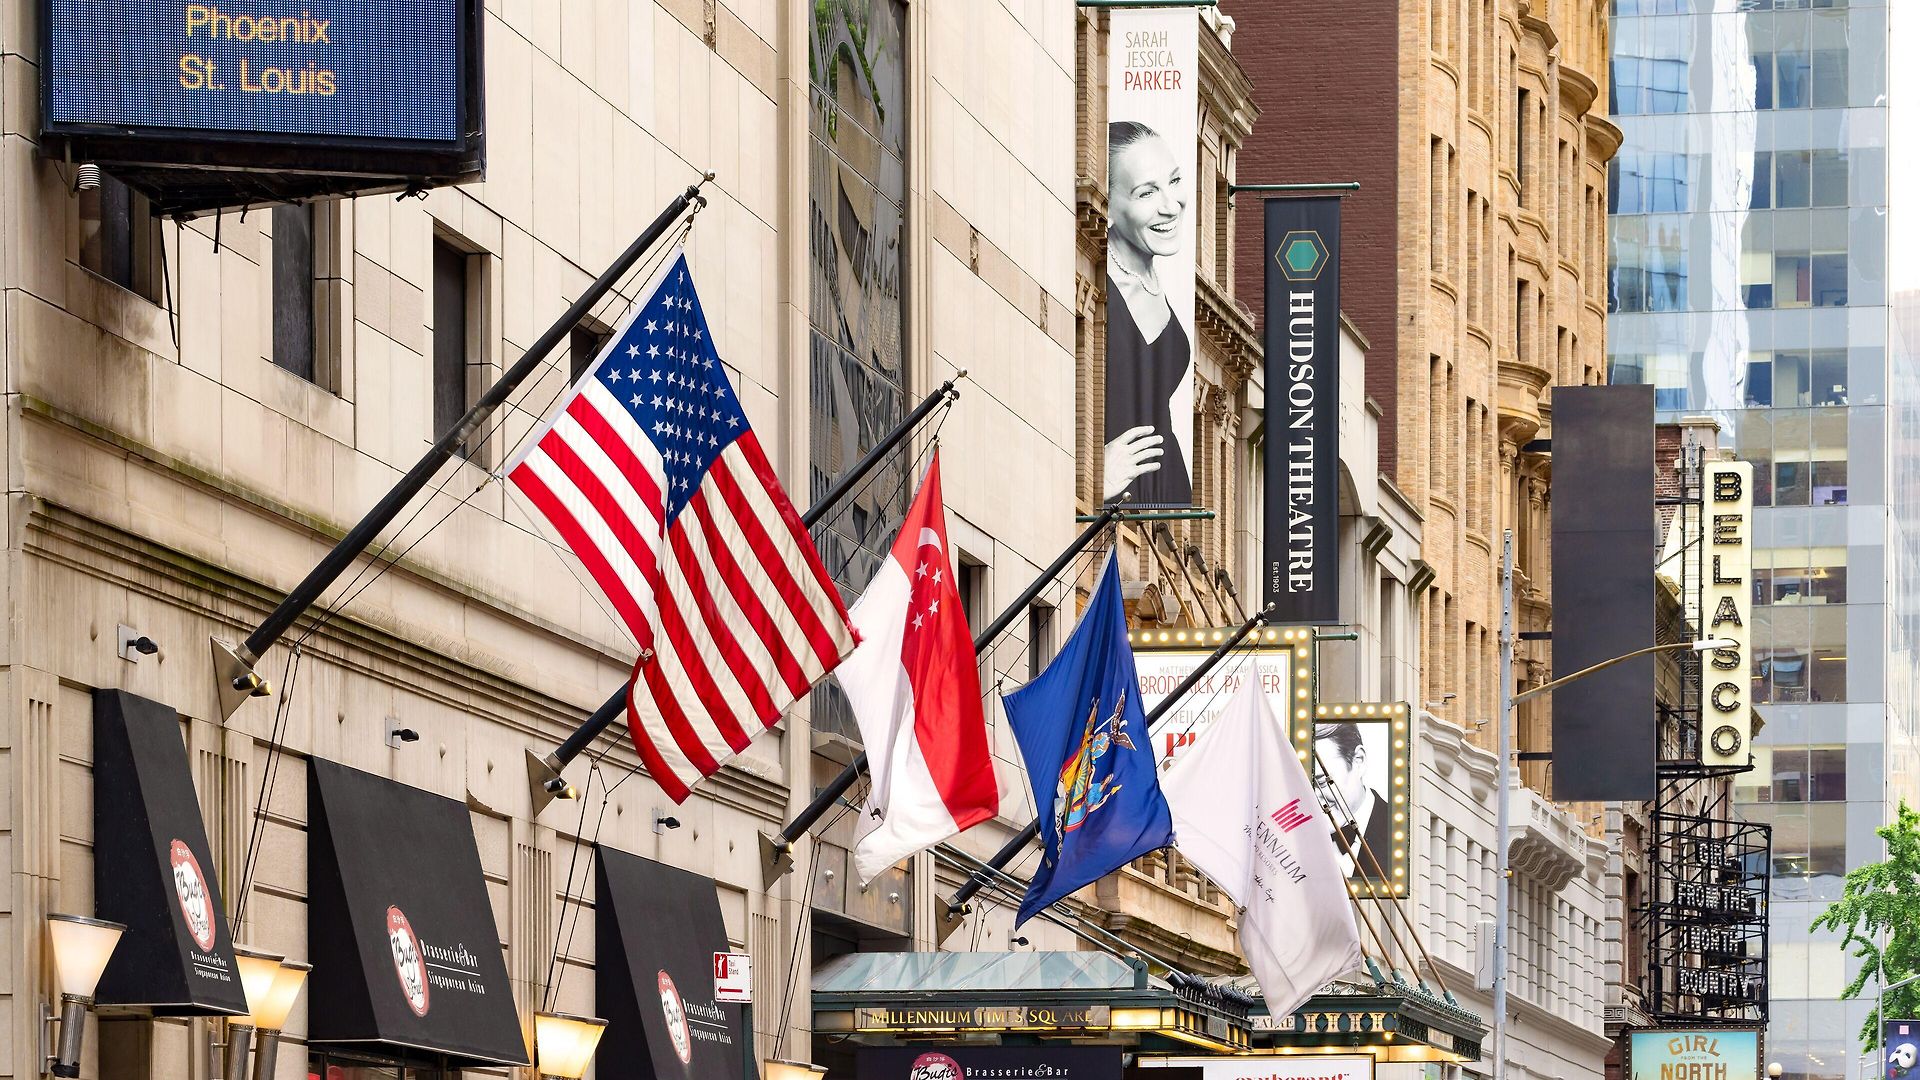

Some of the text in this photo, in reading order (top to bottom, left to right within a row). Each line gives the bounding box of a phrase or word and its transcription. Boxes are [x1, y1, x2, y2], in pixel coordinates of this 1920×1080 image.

[186, 4, 331, 44] Phoenix
[1125, 31, 1168, 48] SARAH
[1125, 50, 1174, 68] JESSICA
[179, 53, 336, 95] St. Louis
[1124, 70, 1182, 91] PARKER
[1288, 290, 1314, 593] HUDSON THEATRE
[1710, 471, 1743, 757] BELASCO
[1224, 674, 1281, 694] PAER
[1677, 883, 1750, 912] FROM THE
[1690, 926, 1739, 952] NORTH
[427, 970, 486, 995] Singaporean Asian
[1680, 969, 1750, 997] COUNTRY
[871, 1010, 971, 1024] MILLENNIUM
[1668, 1035, 1721, 1057] GIRL
[1660, 1062, 1727, 1080] NORTH
